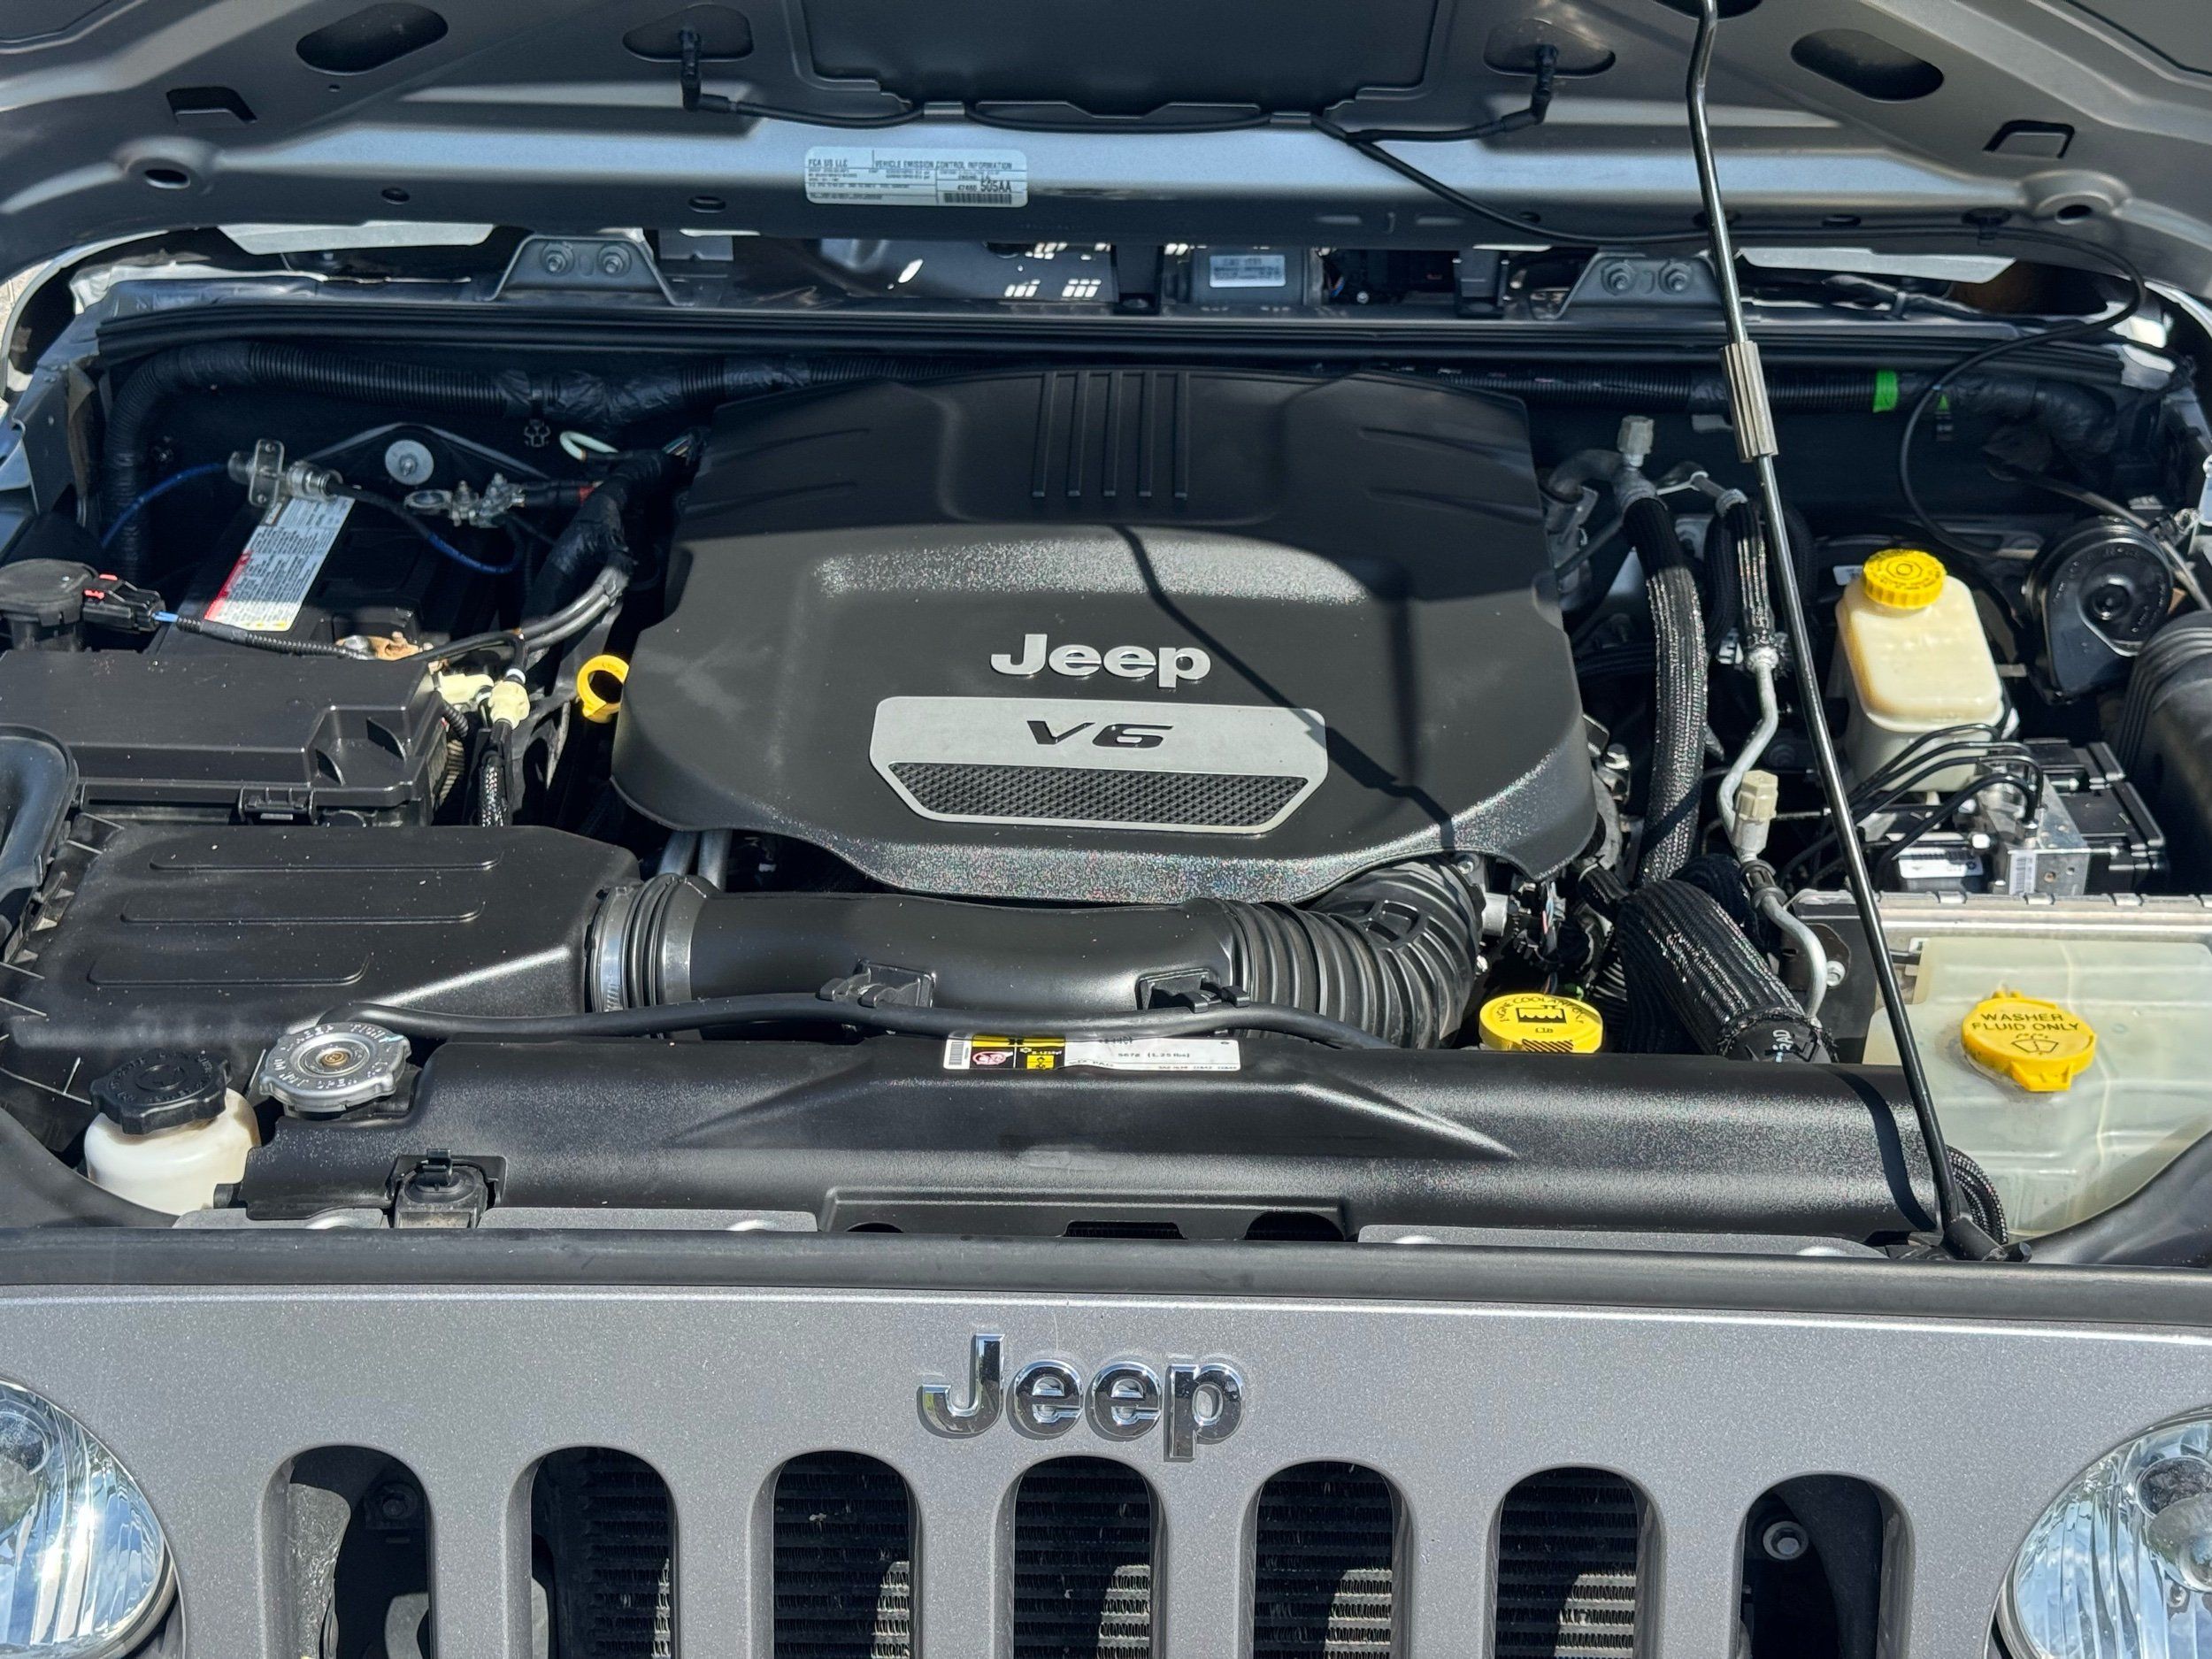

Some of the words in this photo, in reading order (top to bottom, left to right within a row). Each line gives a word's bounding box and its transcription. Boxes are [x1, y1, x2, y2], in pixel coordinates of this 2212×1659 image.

[990, 634, 1211, 688] Jeep
[1026, 720, 1174, 749] V6
[918, 1333, 1243, 1462] Jeep
